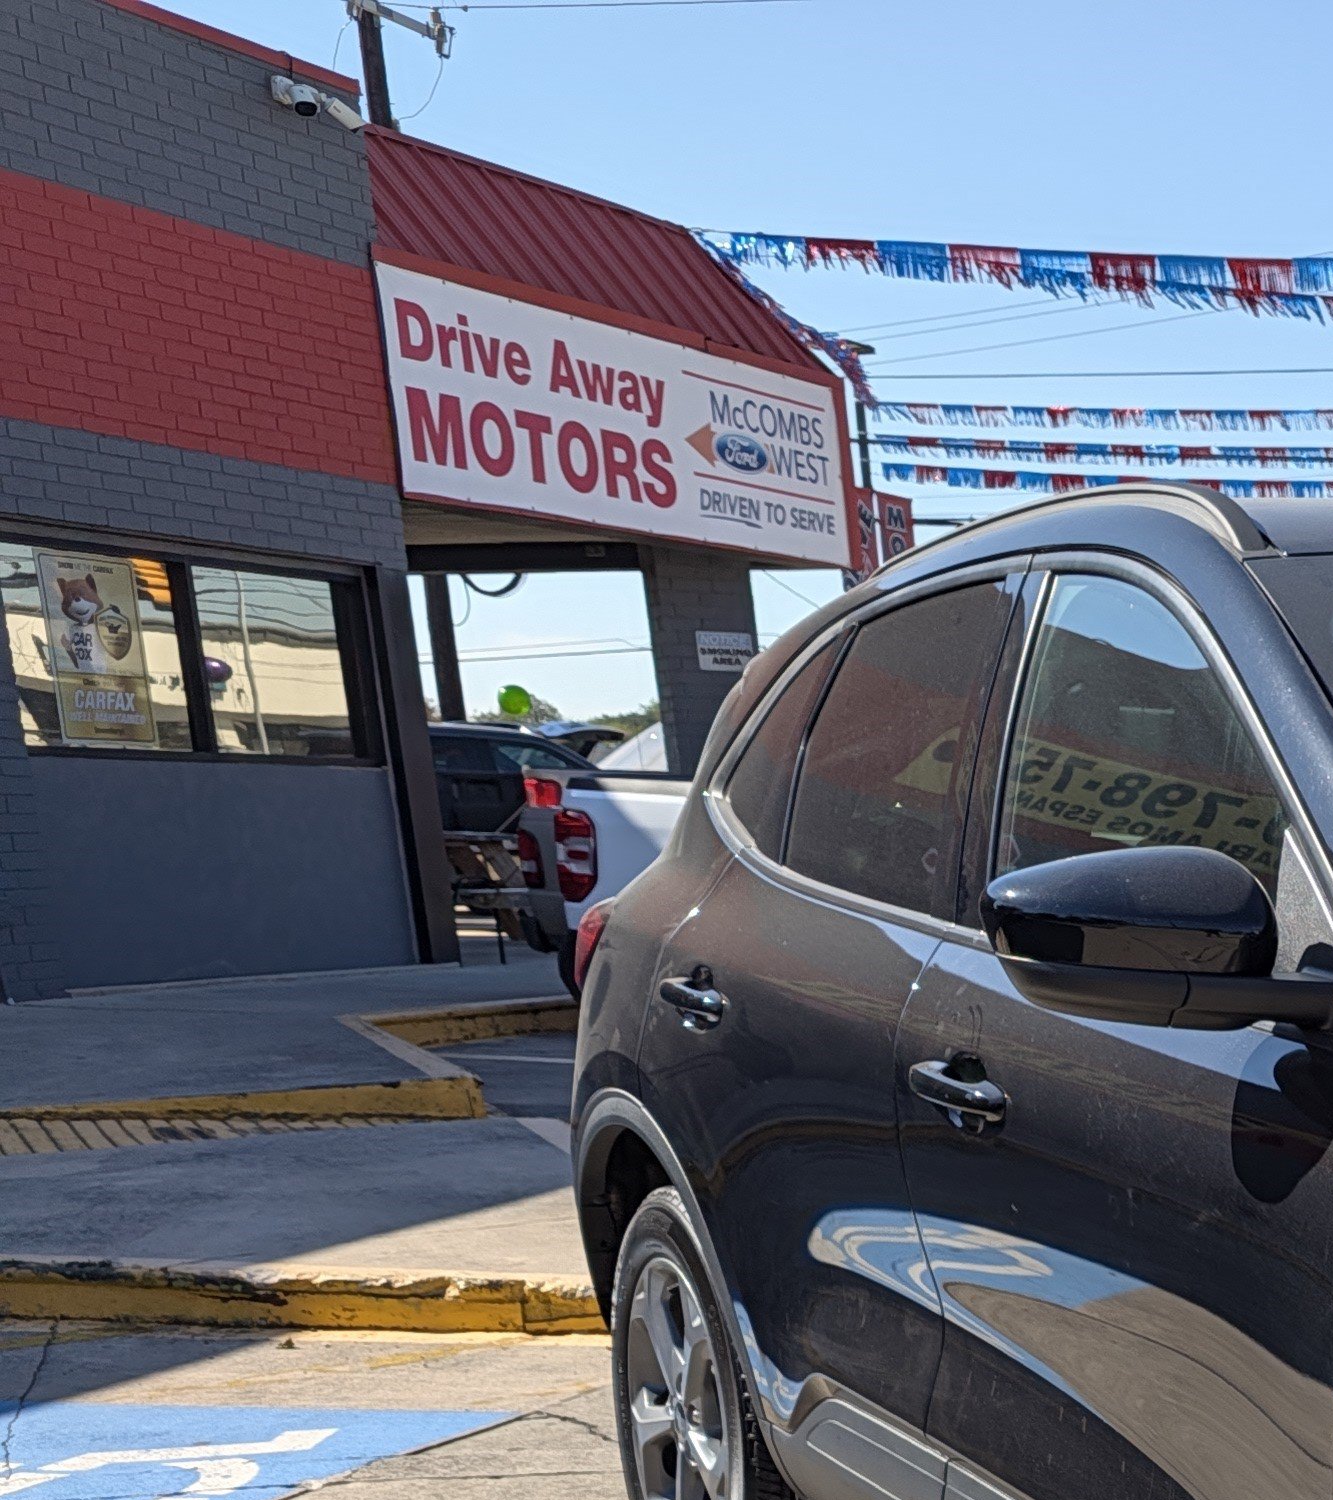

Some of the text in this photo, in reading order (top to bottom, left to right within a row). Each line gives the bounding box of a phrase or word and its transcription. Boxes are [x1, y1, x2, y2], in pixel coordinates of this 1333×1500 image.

[394, 297, 665, 428] Drive Away
[709, 390, 825, 450] McCOMBS
[405, 386, 677, 508] MOTORS
[770, 444, 830, 487] WEST
[700, 488, 761, 522] DRIVEN
[764, 502, 786, 524] TO
[790, 506, 836, 536] SERVE
[713, 657, 742, 665] AREA
[75, 689, 136, 712] CARFAX
